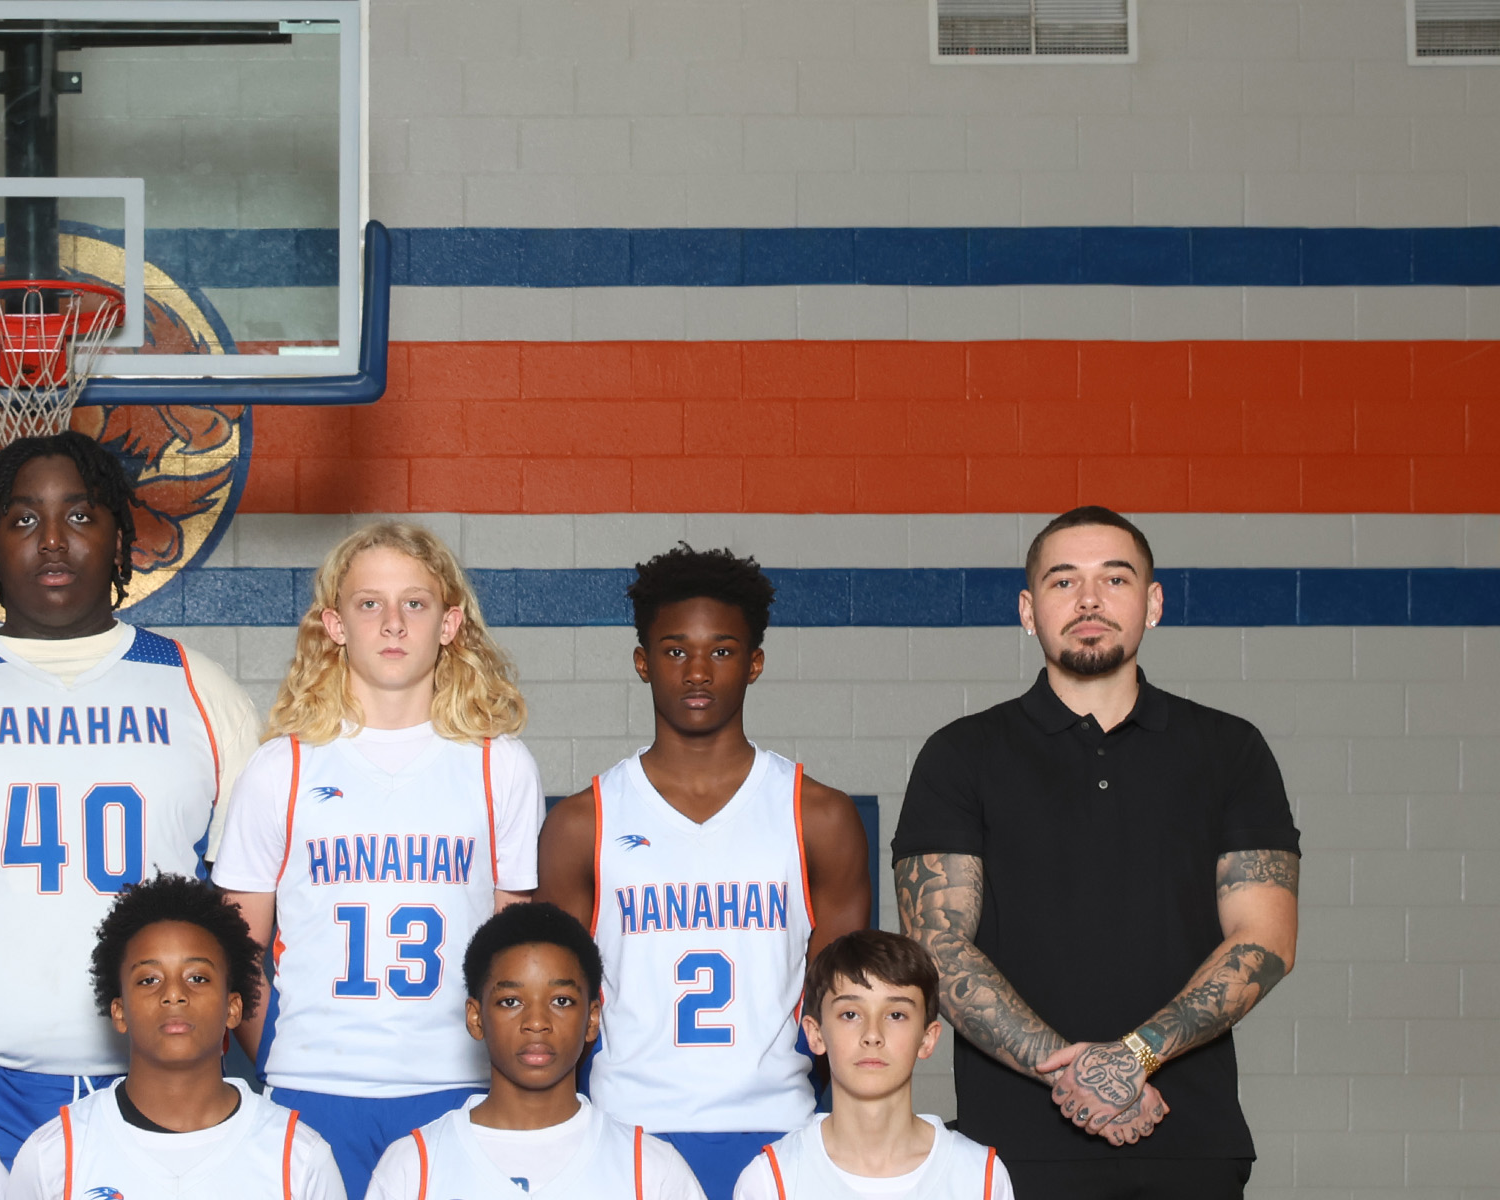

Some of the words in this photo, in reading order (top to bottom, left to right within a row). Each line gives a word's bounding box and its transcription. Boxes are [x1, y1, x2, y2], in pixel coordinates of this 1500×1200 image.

[0, 782, 147, 896] 40
[306, 833, 476, 886] HANAHAN
[332, 902, 447, 1000] 13
[615, 881, 788, 936] HANAHAN
[674, 949, 736, 1048] 2
